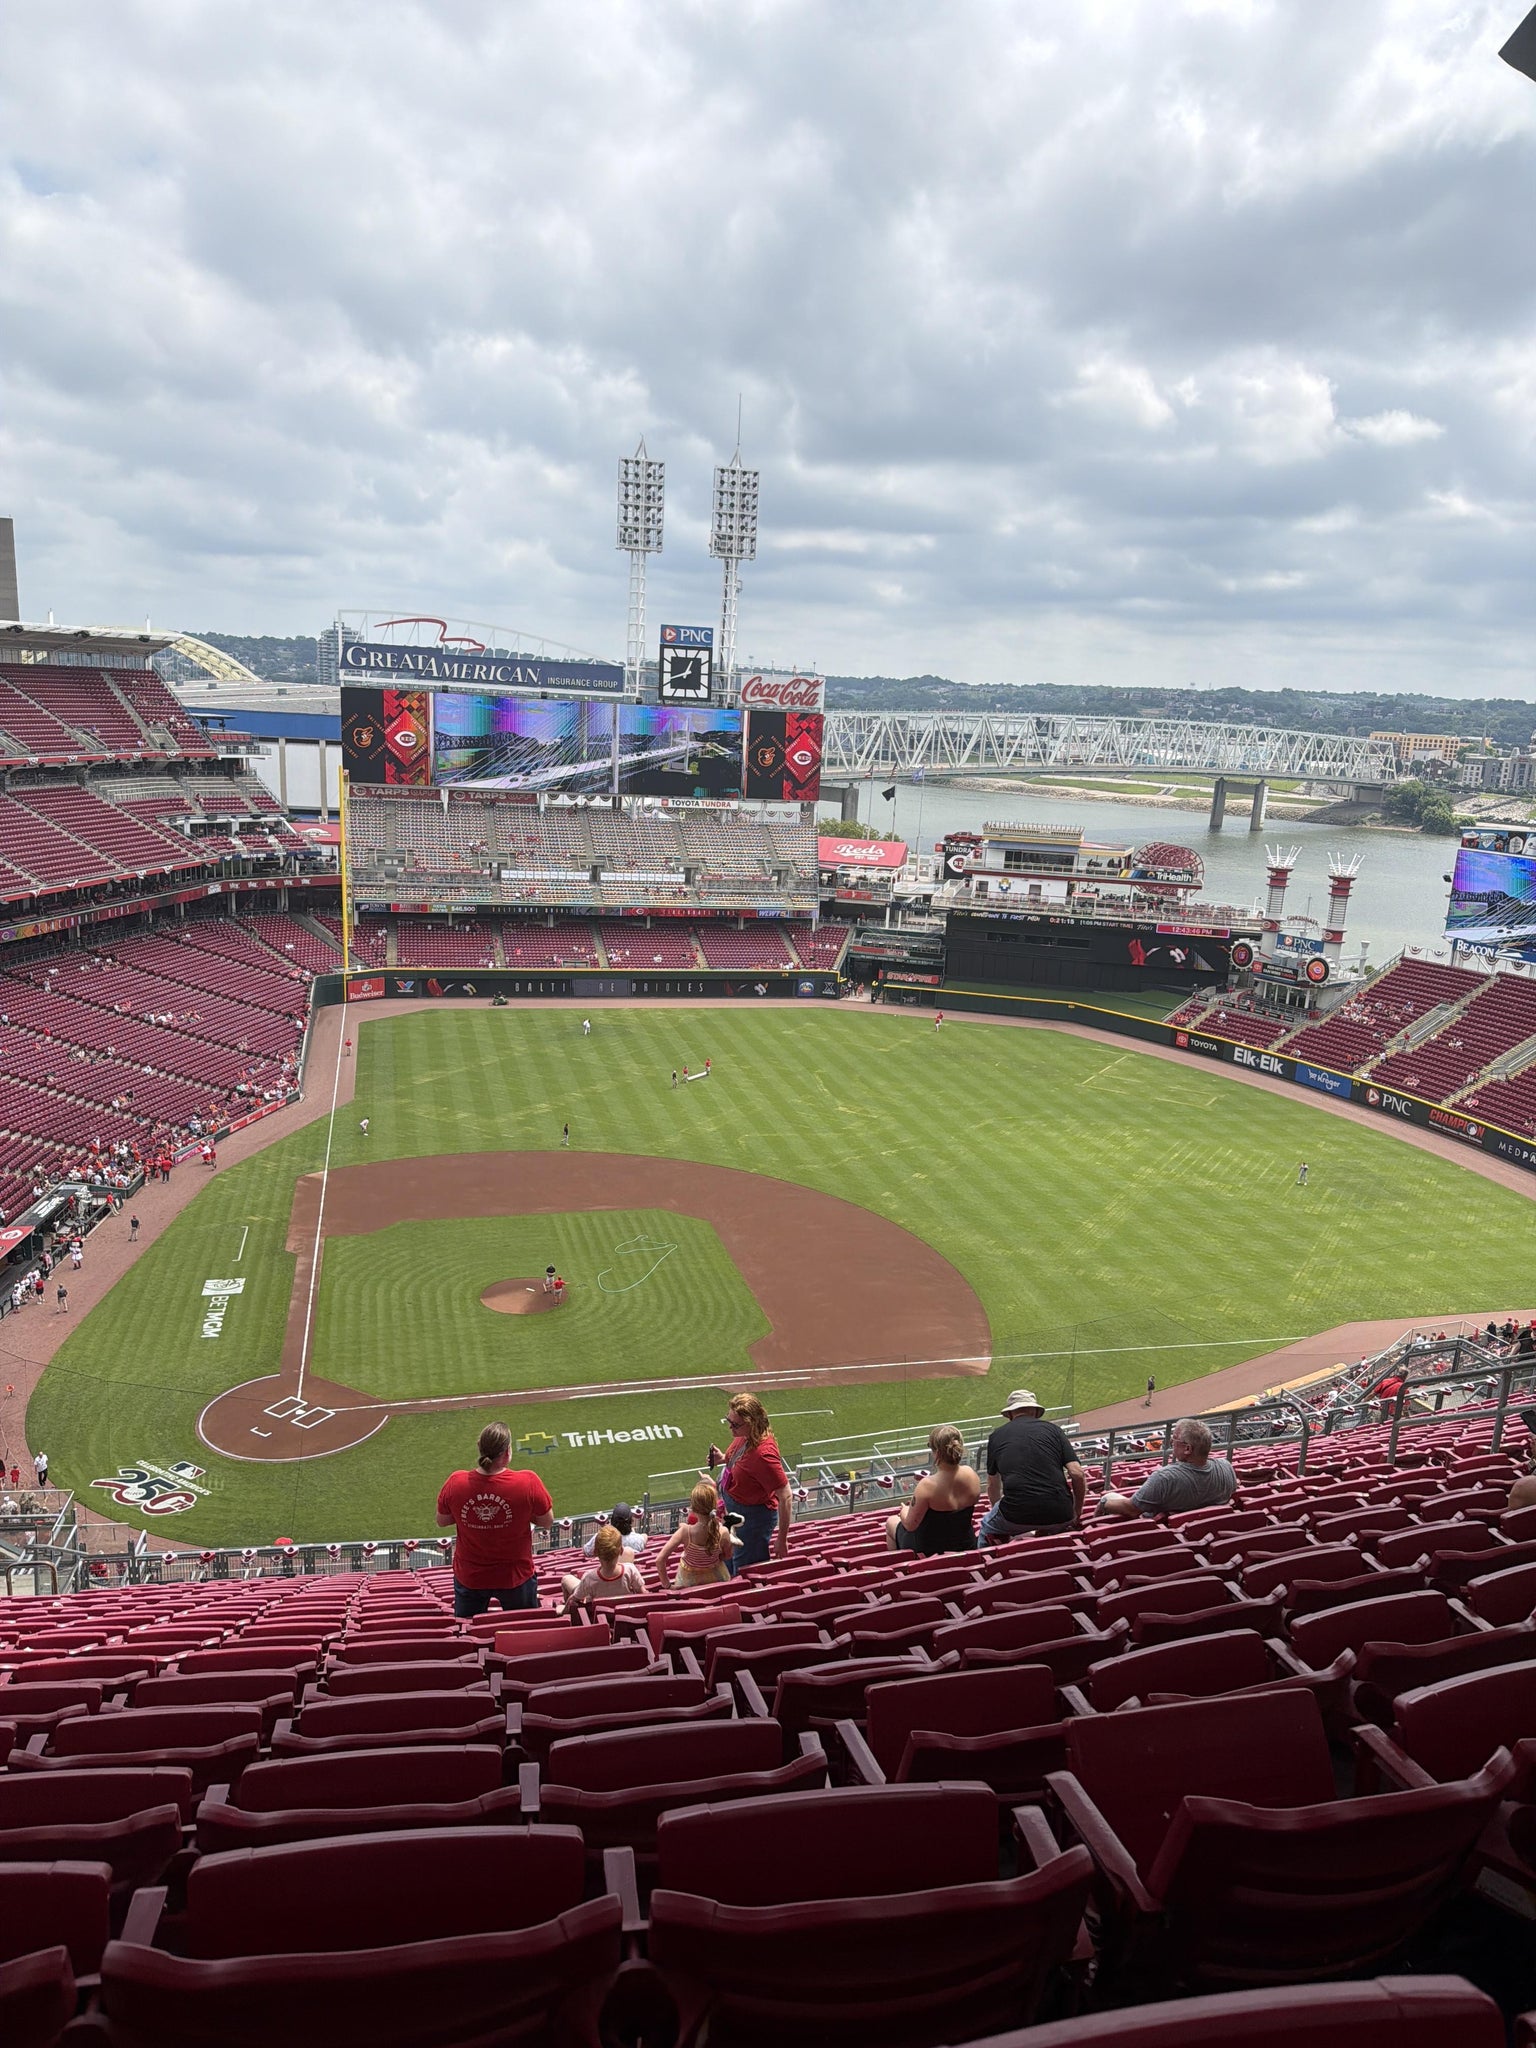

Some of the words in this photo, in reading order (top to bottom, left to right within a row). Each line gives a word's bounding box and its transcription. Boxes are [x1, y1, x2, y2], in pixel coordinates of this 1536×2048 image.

[680, 628, 712, 643] PNC
[547, 677, 591, 687] INSURANCE
[593, 678, 618, 688] GROUP
[369, 787, 409, 795] TARPS
[469, 791, 507, 799] TARPS
[701, 800, 731, 808] TUNDRA
[833, 843, 885, 857] Reds
[945, 845, 971, 853] TUNDRA
[1156, 871, 1192, 882] TriHealth
[1277, 944, 1297, 952] POWER
[1293, 938, 1316, 951] PNC
[1456, 939, 1495, 958] BEACON
[350, 989, 384, 1000] Budweiser
[1190, 1038, 1218, 1052] TOYOTA
[1317, 1072, 1341, 1090] Kroger
[1381, 1093, 1412, 1116] PNC
[201, 1295, 229, 1338] BETMGM
[562, 1424, 683, 1448] TriHealth
[461, 1498, 475, 1519] BEE'S
[476, 1493, 513, 1520] BARBECUE
